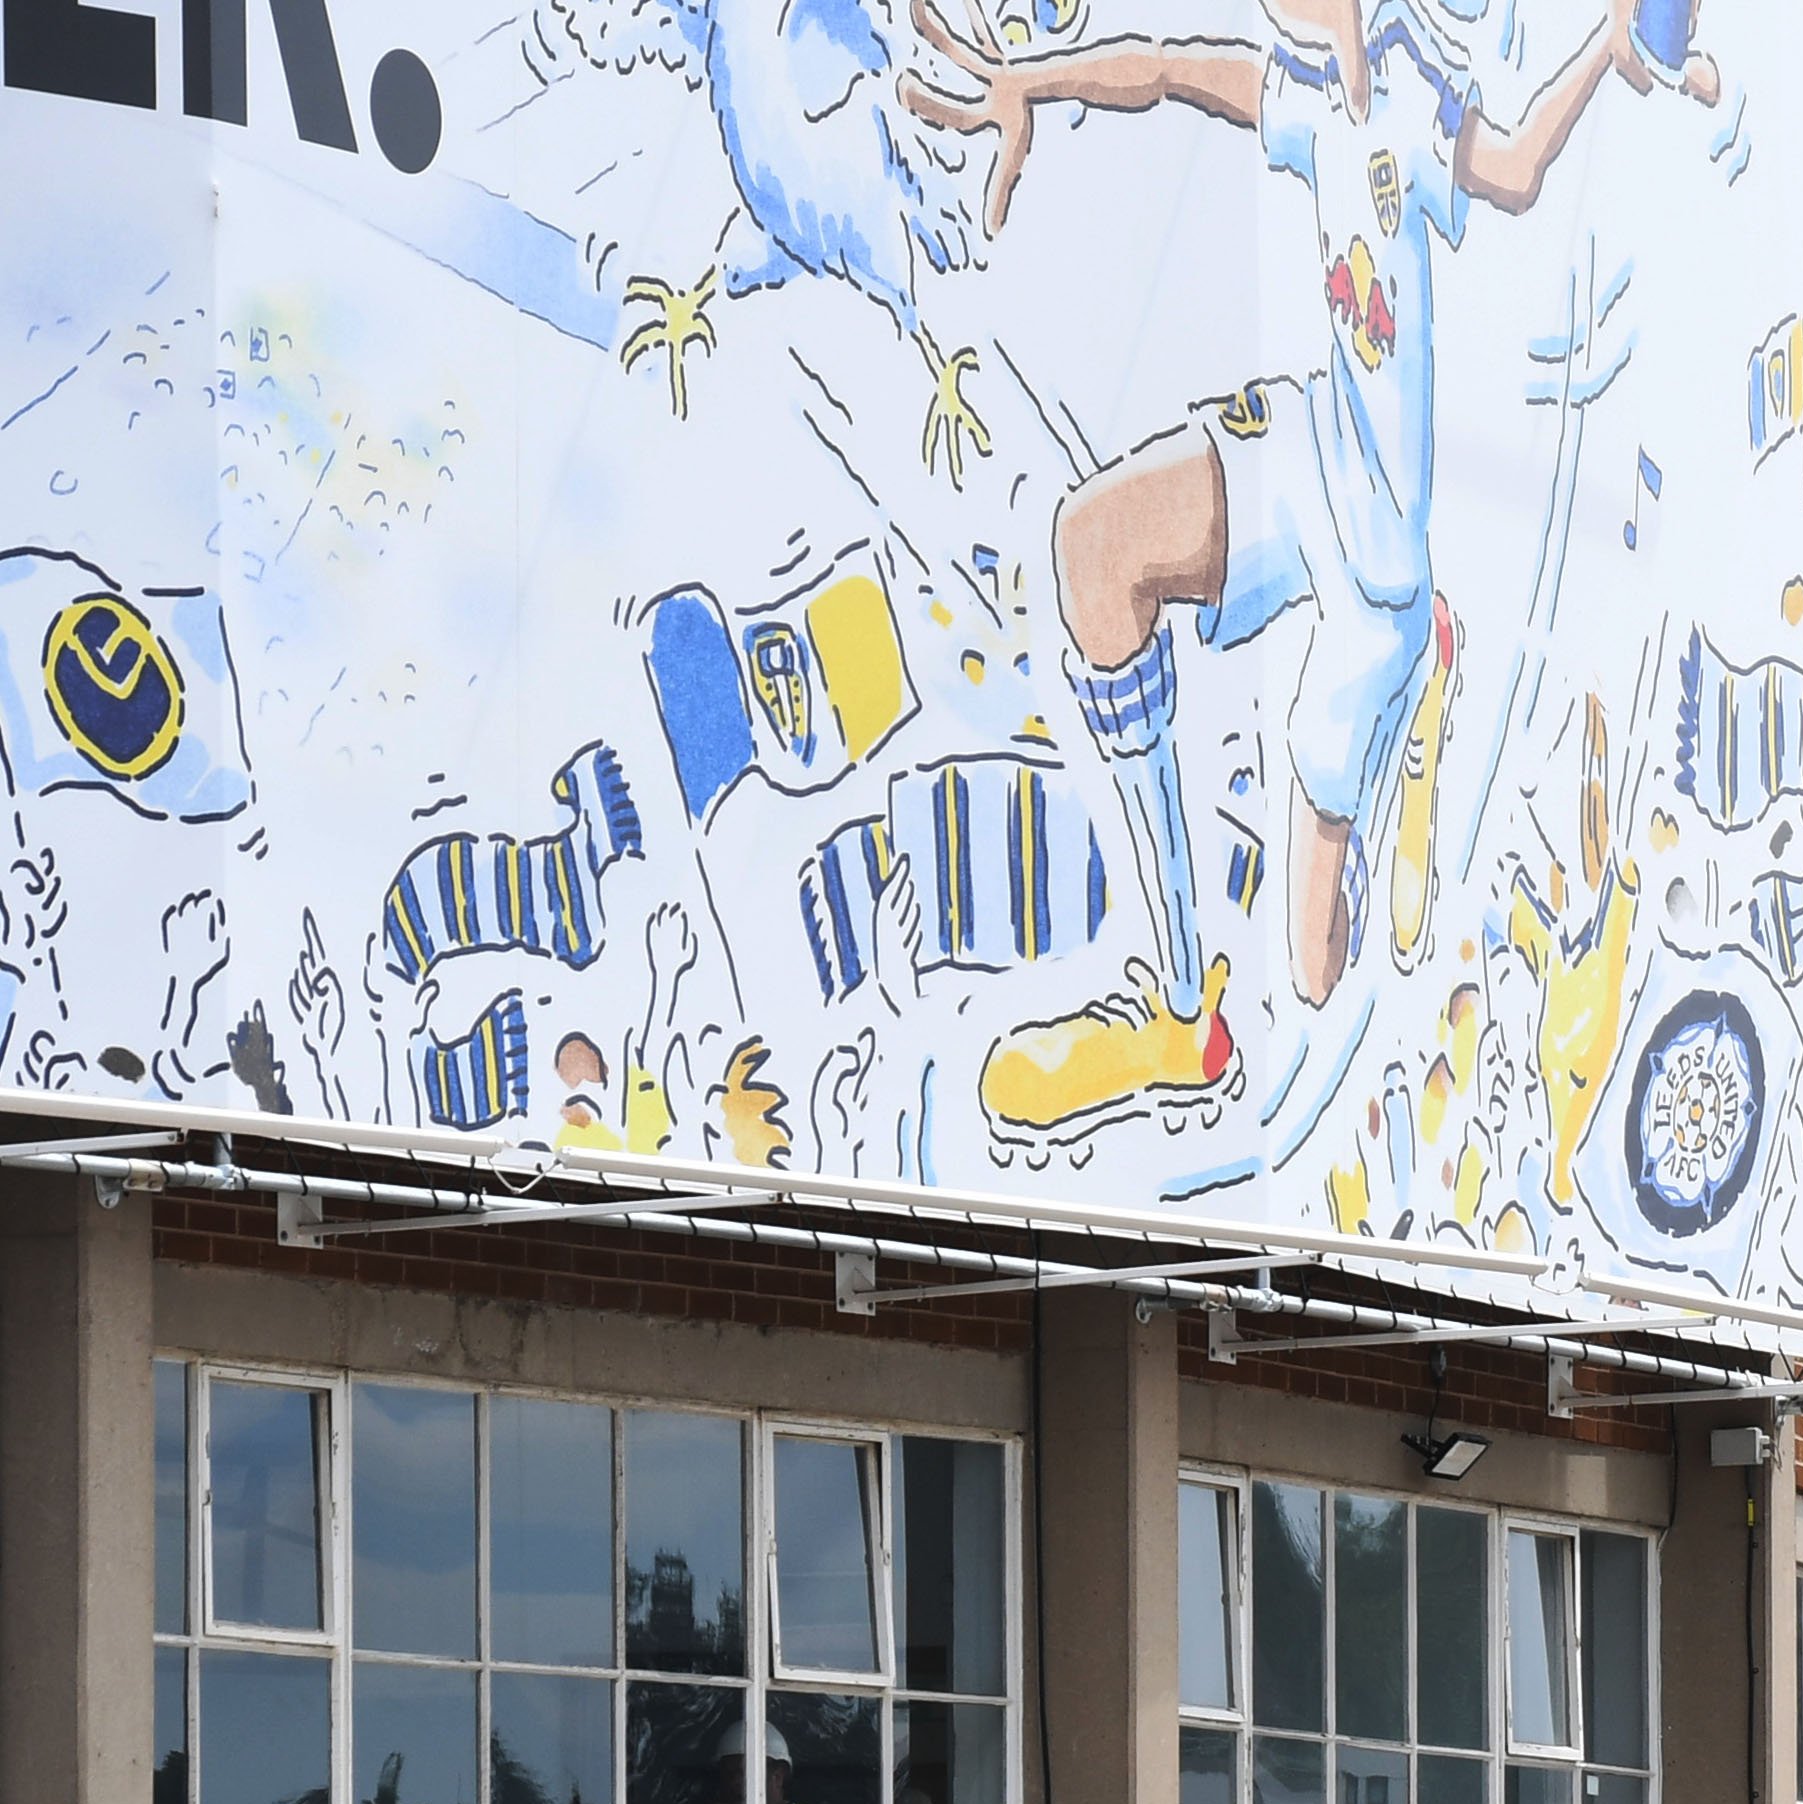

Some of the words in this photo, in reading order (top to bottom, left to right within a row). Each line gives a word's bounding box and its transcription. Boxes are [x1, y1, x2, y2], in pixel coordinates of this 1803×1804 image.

[1653, 1045, 1706, 1134] LEEDS
[1714, 1052, 1739, 1160] UNITED
[1663, 1152, 1702, 1182] AFC
